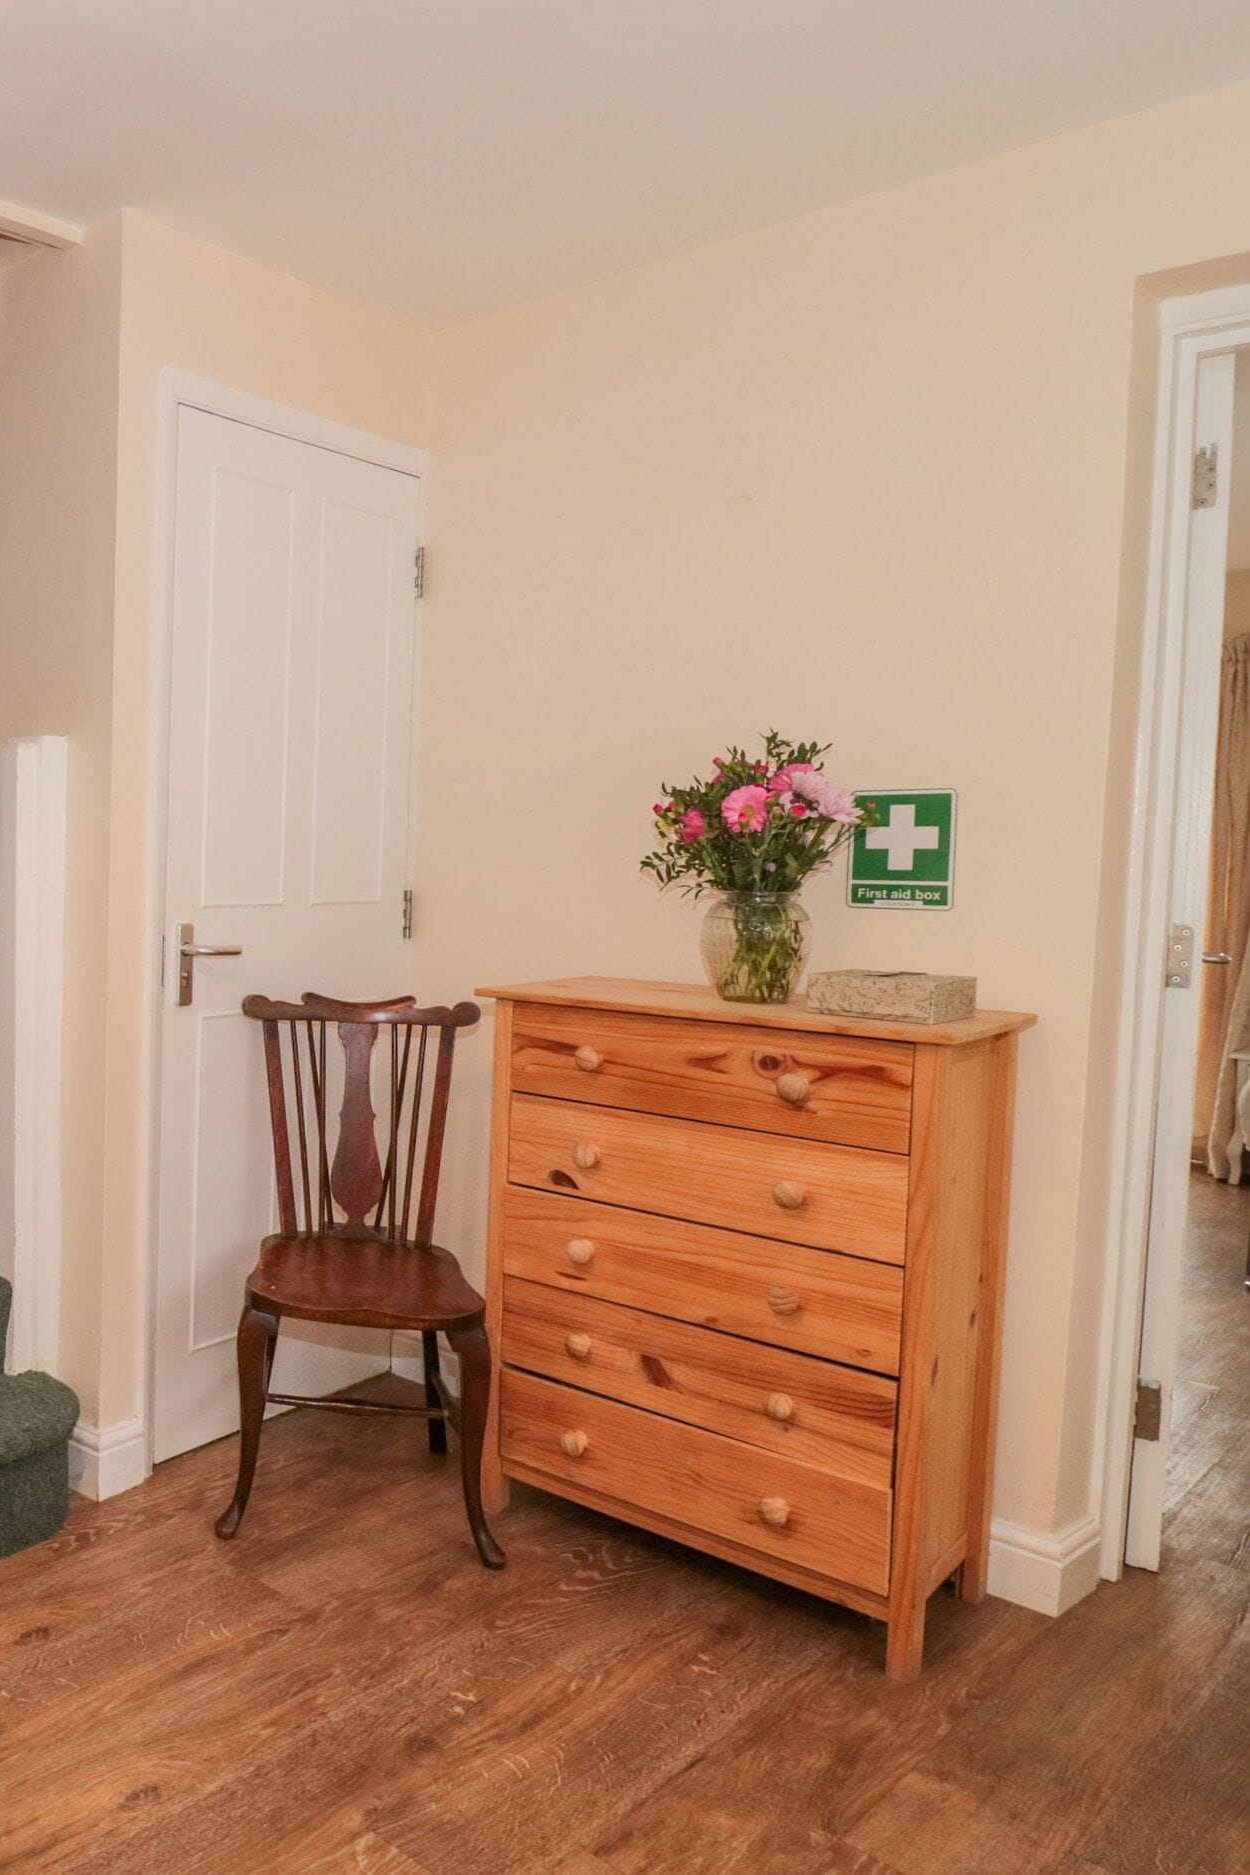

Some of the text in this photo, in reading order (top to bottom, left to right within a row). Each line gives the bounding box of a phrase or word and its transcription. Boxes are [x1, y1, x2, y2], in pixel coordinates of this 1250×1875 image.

[857, 887, 942, 900] First aid box
